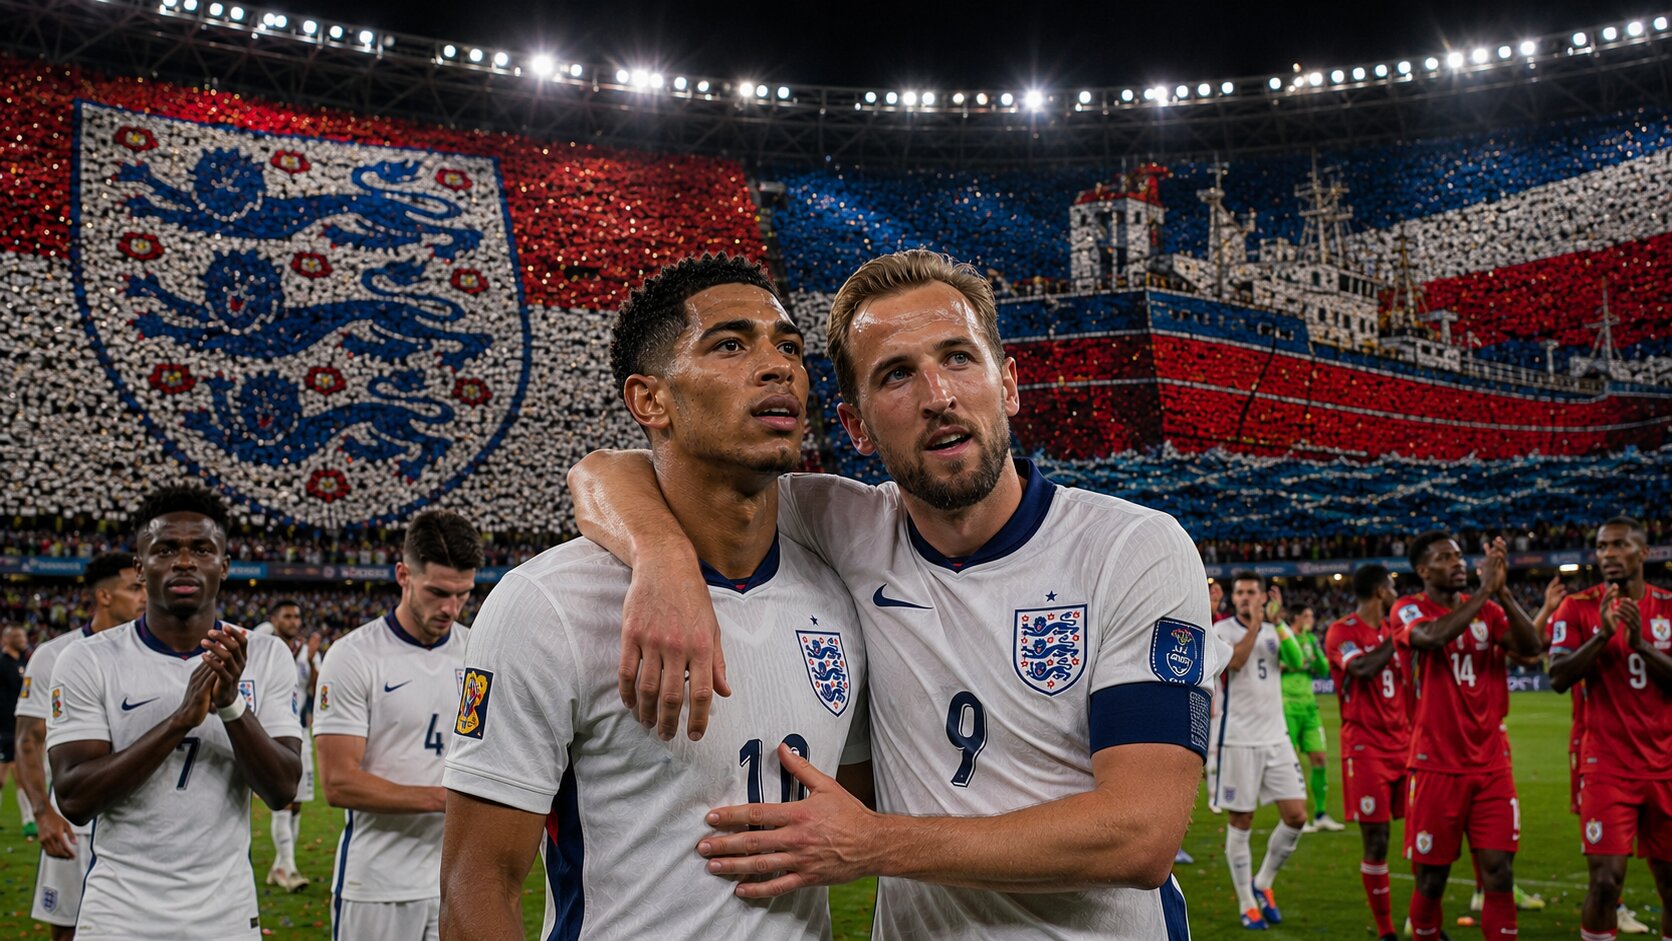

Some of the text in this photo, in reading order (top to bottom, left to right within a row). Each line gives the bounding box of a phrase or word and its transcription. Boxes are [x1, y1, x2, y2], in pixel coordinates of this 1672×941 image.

[1257, 658, 1267, 680] 5
[1382, 669, 1395, 698] 9
[1451, 652, 1476, 688] 14
[1628, 652, 1647, 689] 9
[424, 713, 444, 756] 4
[946, 690, 989, 788] 9
[176, 737, 200, 791] 7
[739, 733, 811, 831] 10
